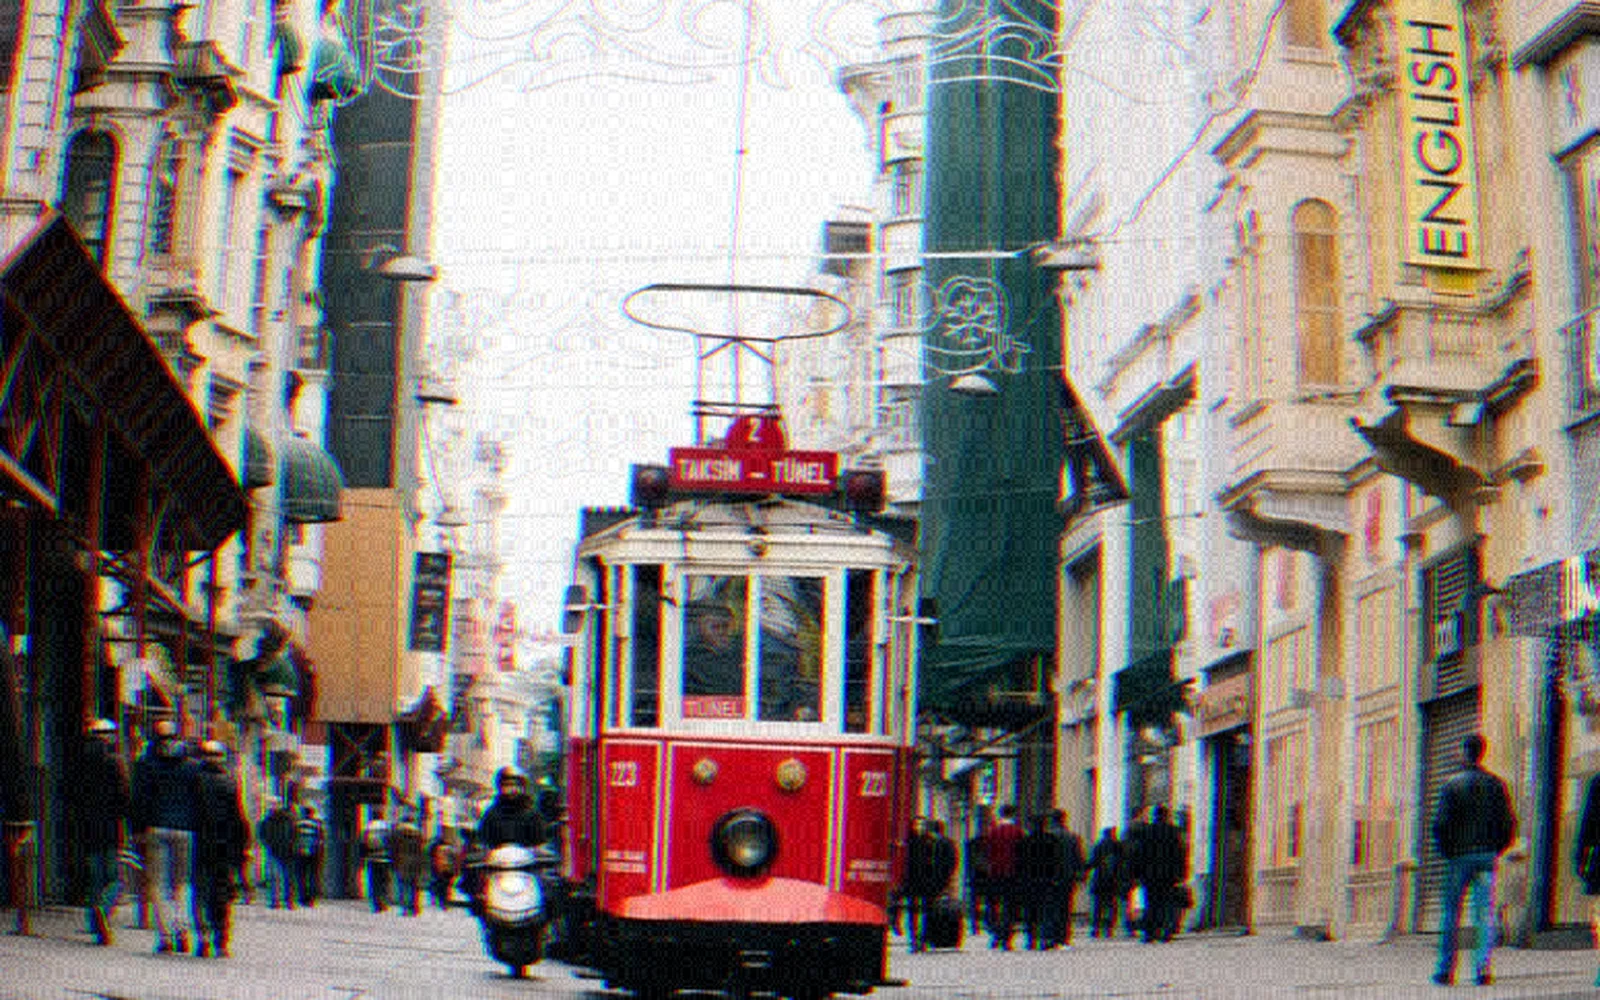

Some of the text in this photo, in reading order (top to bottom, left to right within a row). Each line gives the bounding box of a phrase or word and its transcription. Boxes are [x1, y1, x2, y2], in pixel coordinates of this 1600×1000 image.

[1408, 20, 1468, 258] ENGLISH
[746, 417, 762, 442] 2
[771, 456, 832, 485] TÜNEL
[609, 761, 638, 787] 223
